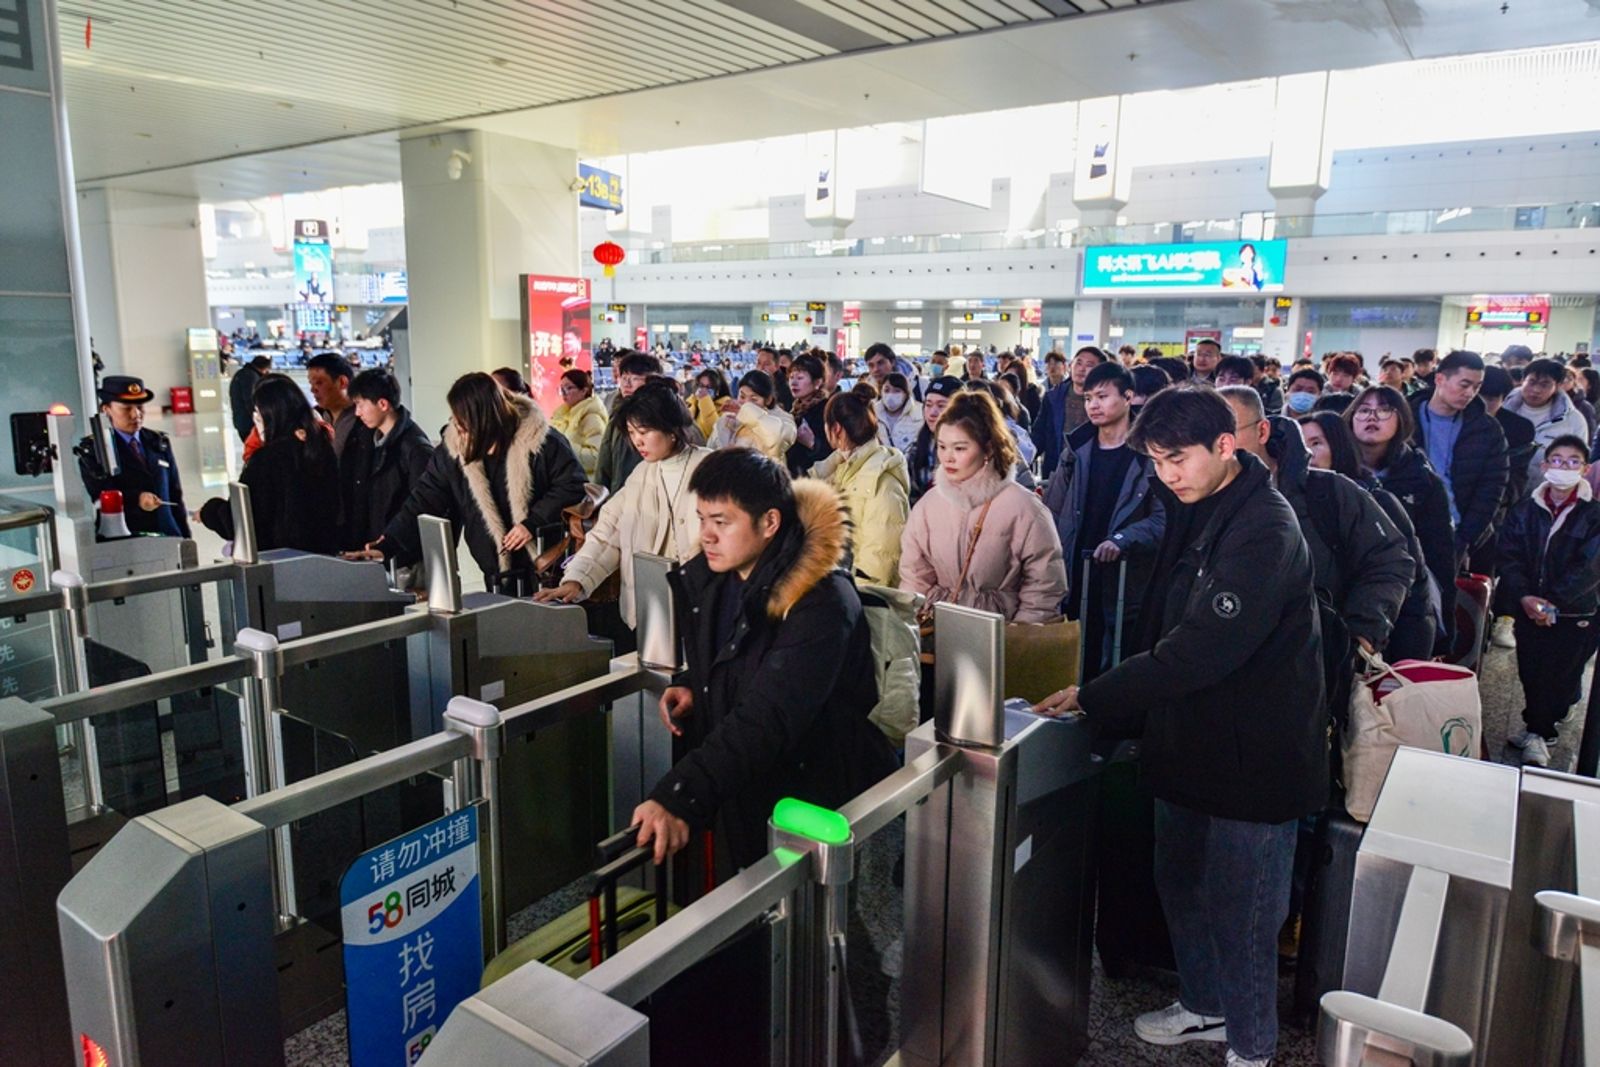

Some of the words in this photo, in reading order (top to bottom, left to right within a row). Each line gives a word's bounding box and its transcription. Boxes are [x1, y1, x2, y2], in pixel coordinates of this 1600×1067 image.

[370, 814, 470, 884] 请勿冲撞
[368, 866, 456, 935] 58同城
[397, 931, 437, 1035] 找房
